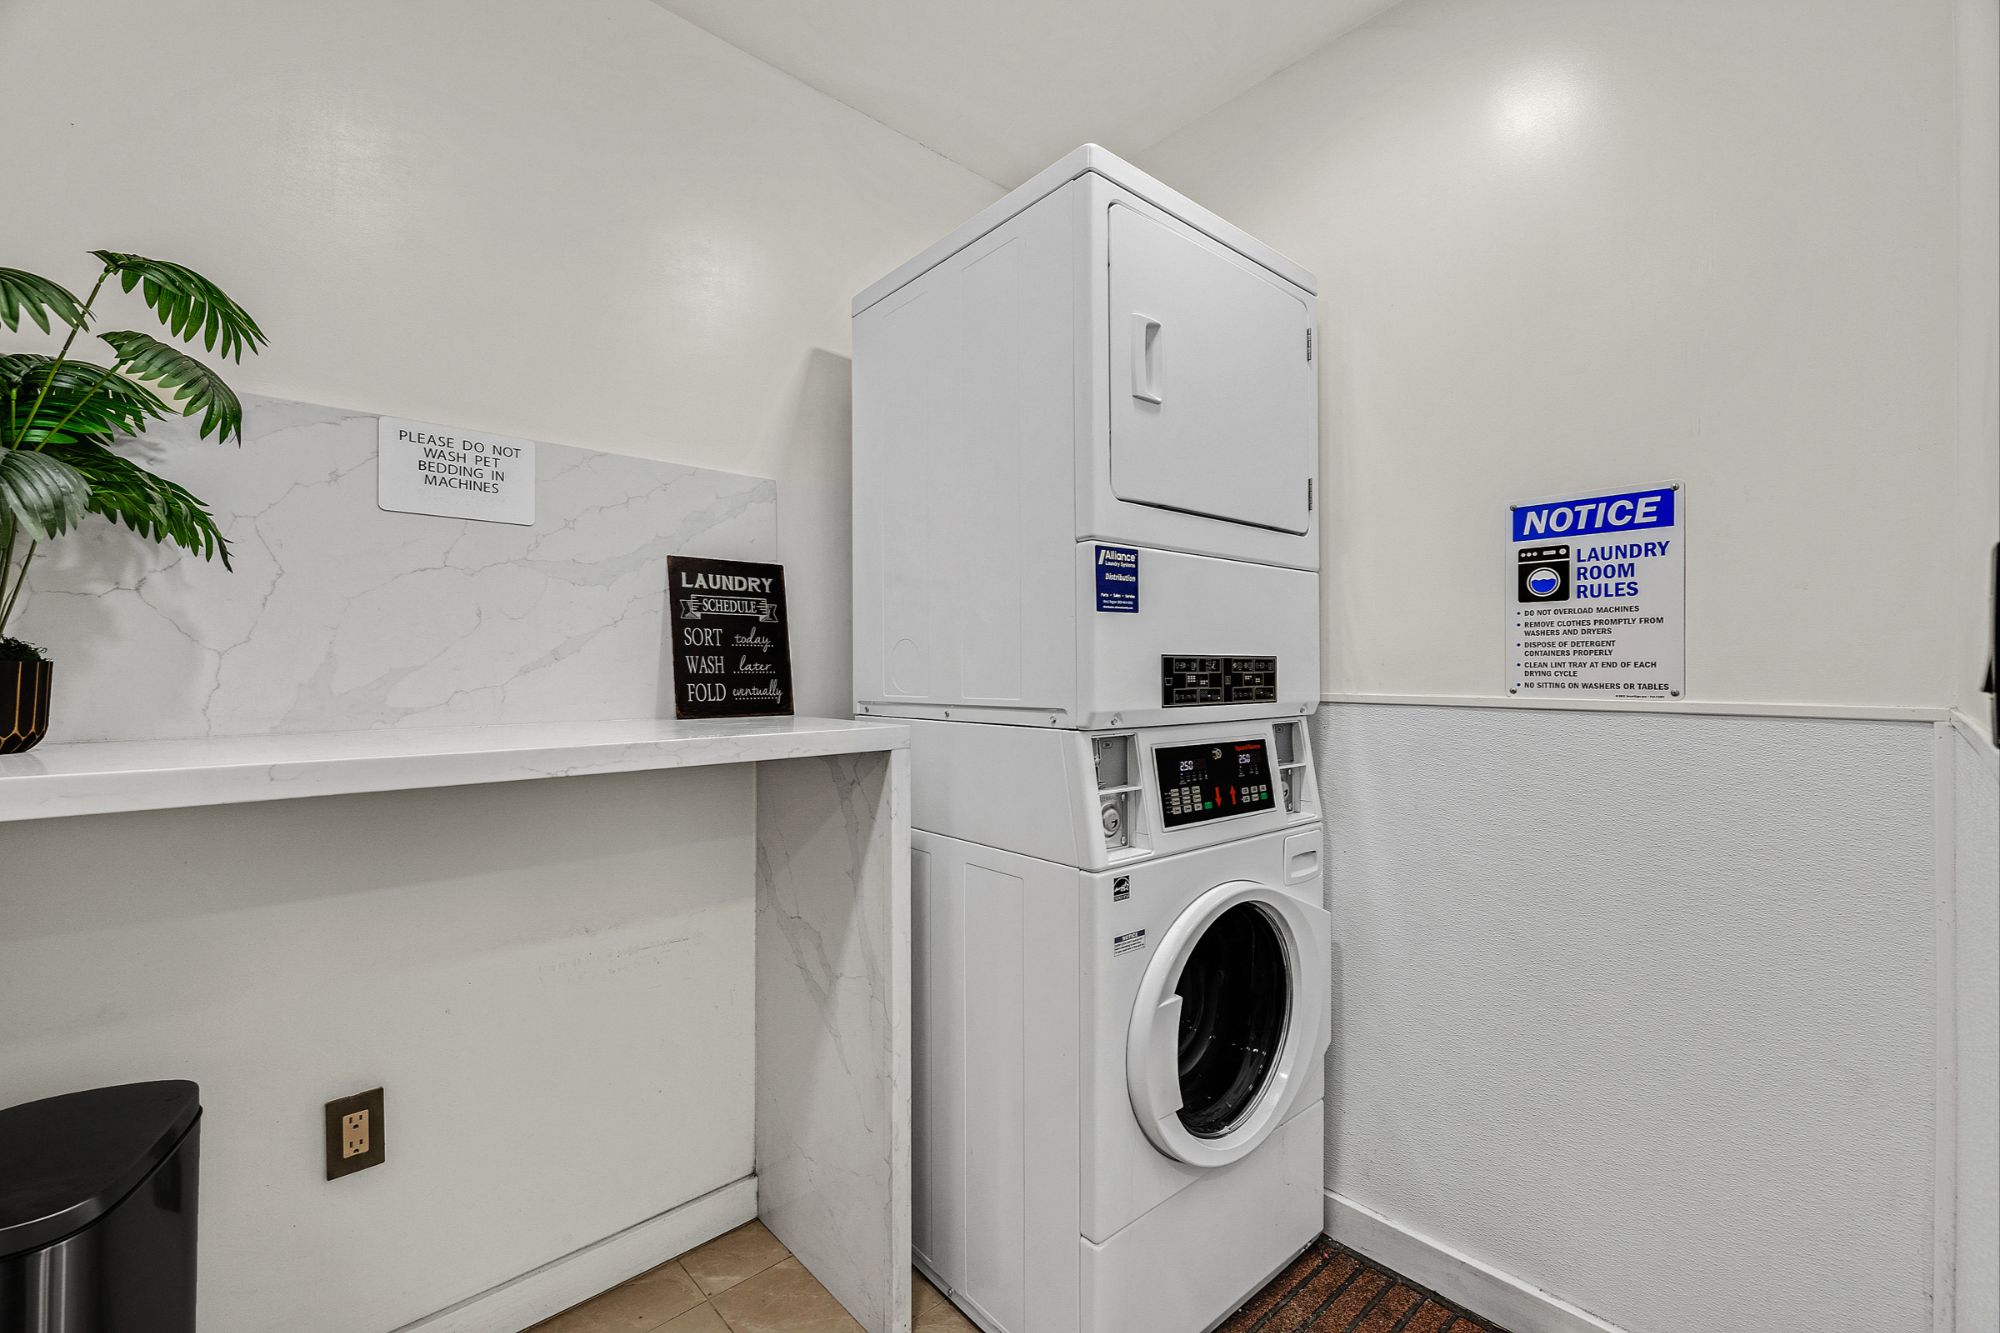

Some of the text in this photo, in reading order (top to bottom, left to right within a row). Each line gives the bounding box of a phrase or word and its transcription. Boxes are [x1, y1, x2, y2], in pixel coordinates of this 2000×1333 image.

[399, 430, 521, 458] PLEASE DO NOT
[423, 447, 500, 468] WASH PET
[418, 460, 505, 482] BEDDING IN
[424, 474, 499, 494] MACHINES
[1522, 495, 1662, 536] NOTICE
[1105, 550, 1136, 562] Alliance
[1576, 540, 1671, 563] LAUNDRY
[1105, 573, 1136, 582] Distribution
[1576, 563, 1635, 581] ROOM
[681, 572, 774, 593] LAUNDRY
[1576, 581, 1639, 599] RULES
[702, 598, 757, 613] SCHEDULE
[1553, 607, 1593, 615] OVERLOAD
[1596, 605, 1640, 613] MACHINES
[1557, 619, 1591, 627] CLOTHES
[1593, 618, 1637, 626] PROMPTLY
[684, 626, 771, 652] SORT today
[685, 654, 772, 674] WASH later
[686, 679, 783, 704] FOLD eventually
[1581, 682, 1621, 690] WASHERS
